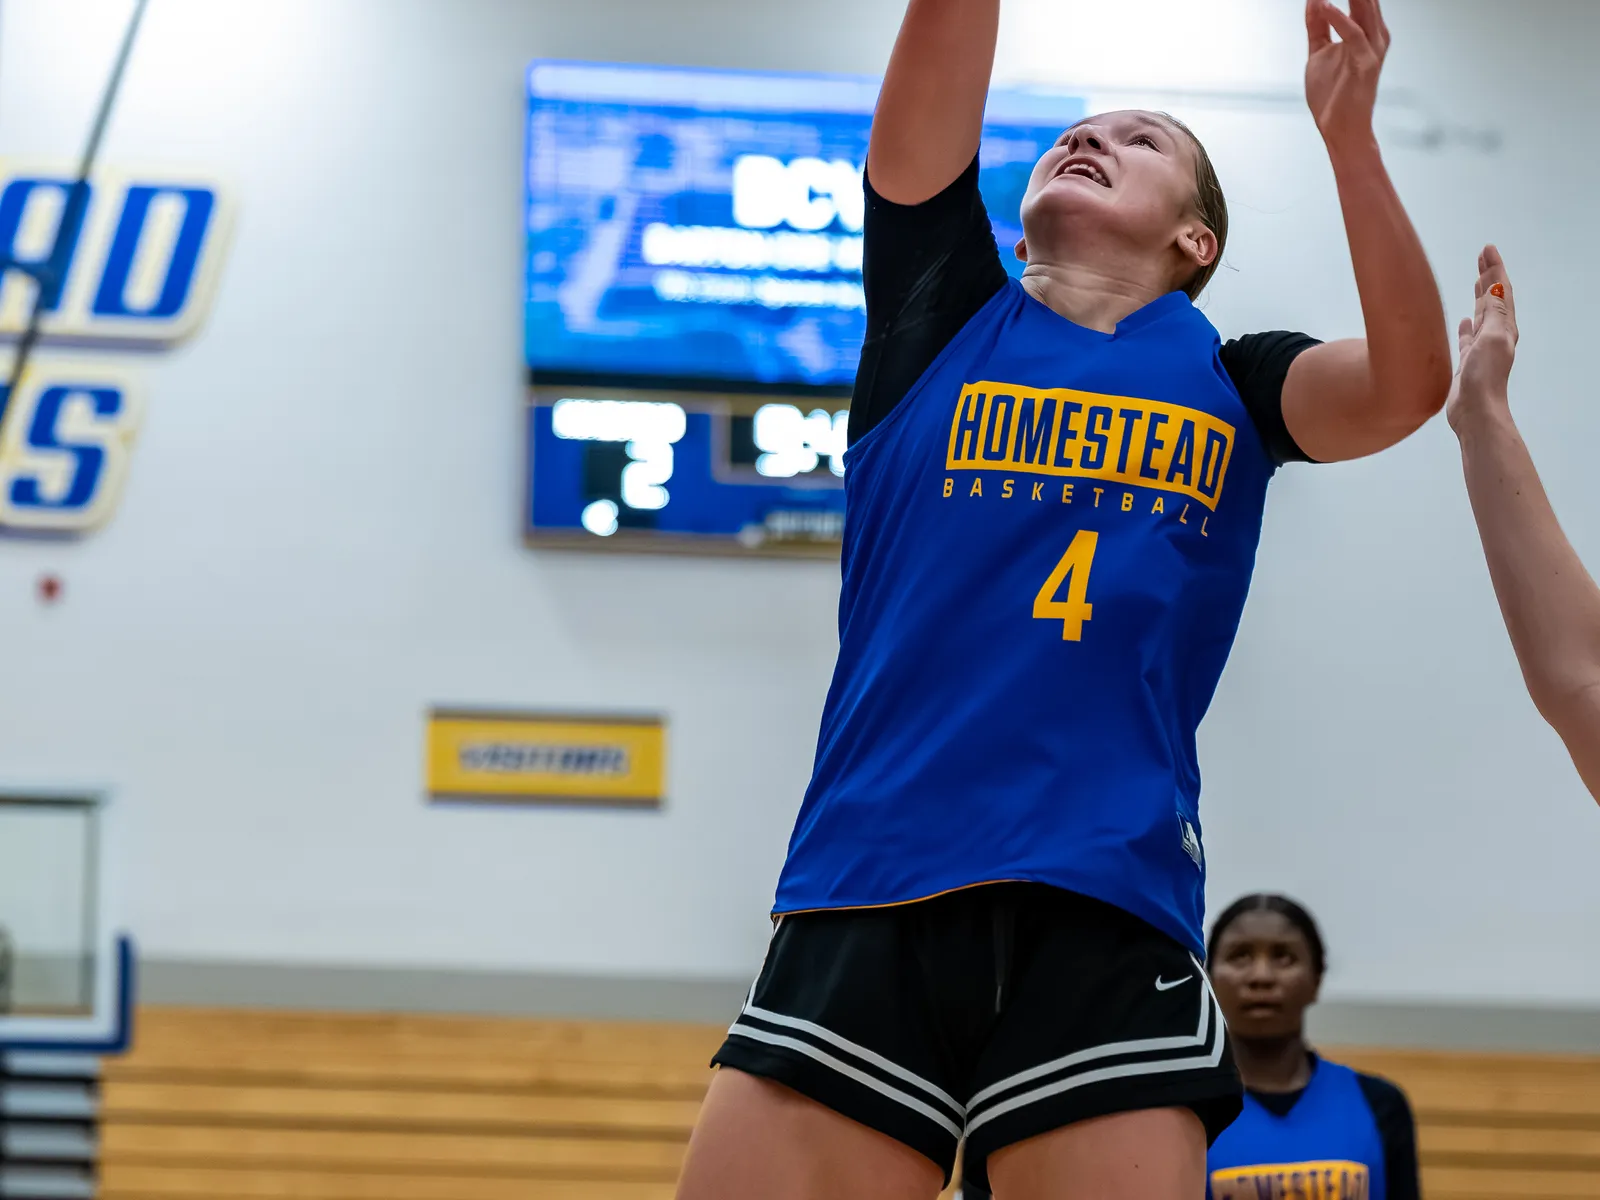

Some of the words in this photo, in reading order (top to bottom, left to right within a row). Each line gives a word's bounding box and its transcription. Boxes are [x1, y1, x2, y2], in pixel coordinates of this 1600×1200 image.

[0, 384, 123, 508] S
[953, 392, 1228, 498] HOMESTEAD
[942, 477, 1209, 537] BASKETBALL
[1032, 529, 1099, 642] 4
